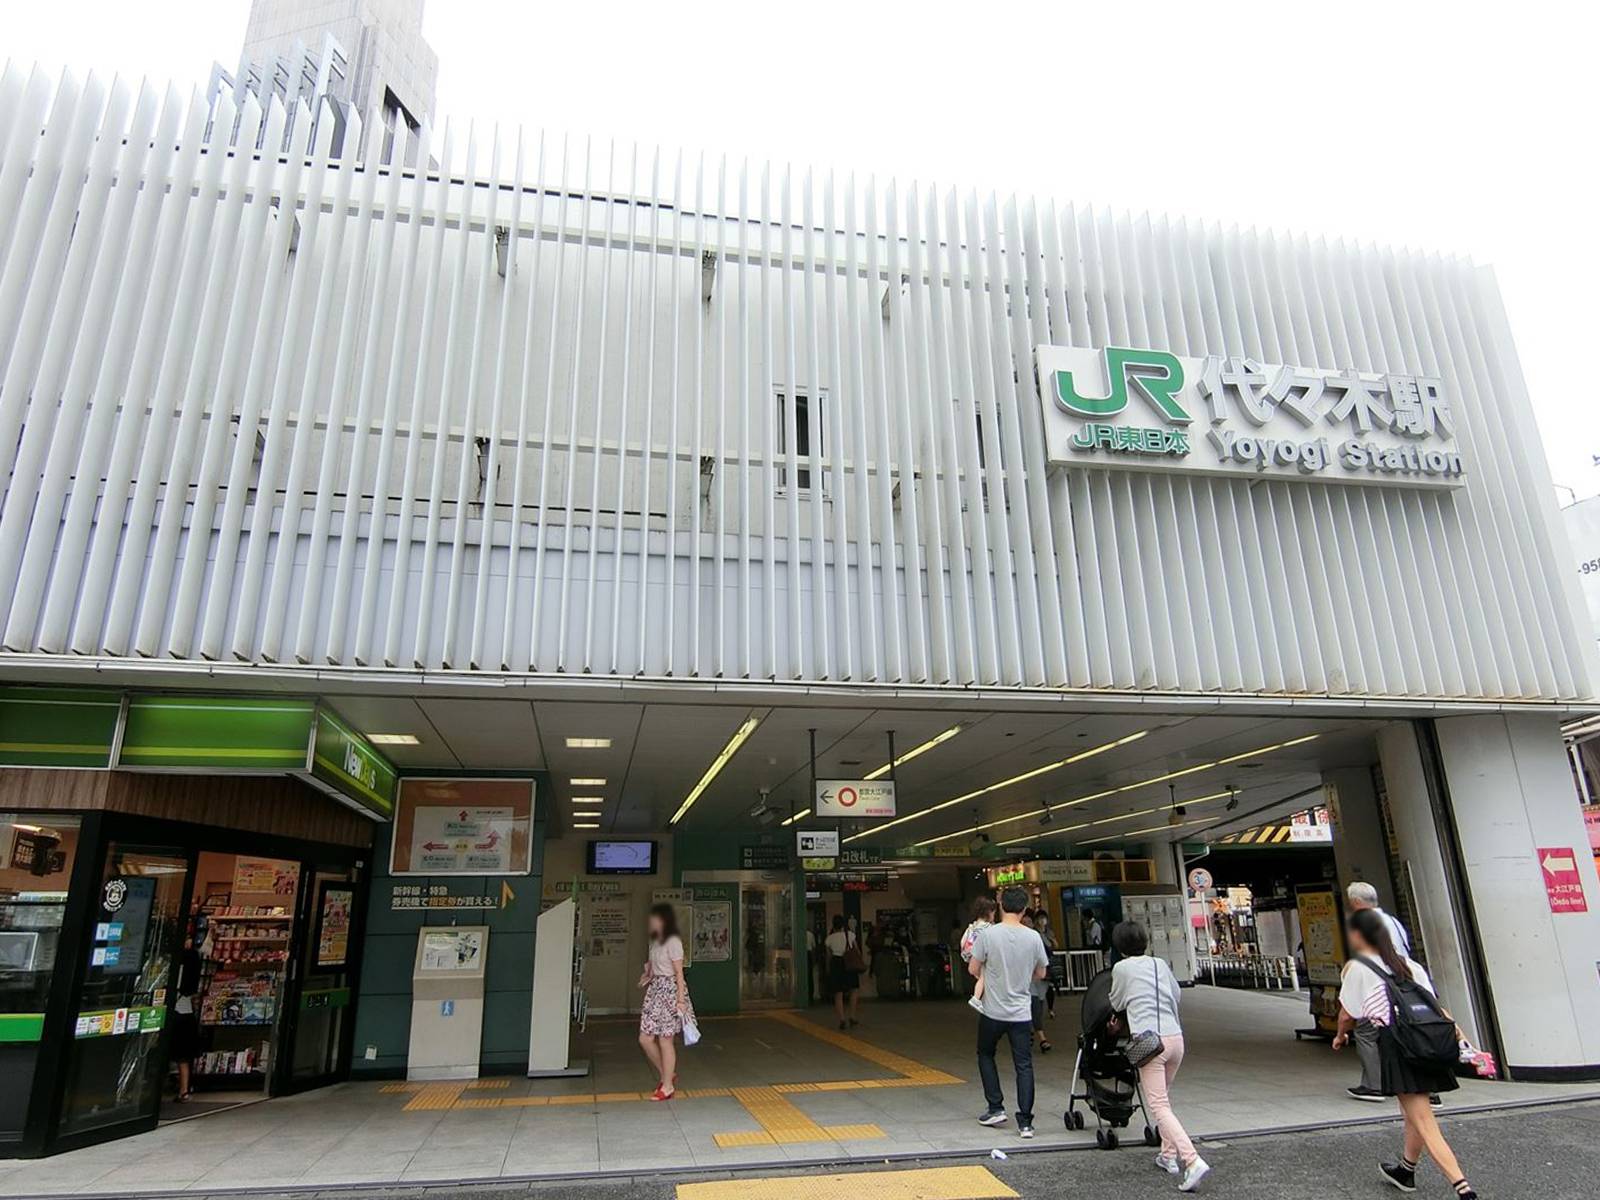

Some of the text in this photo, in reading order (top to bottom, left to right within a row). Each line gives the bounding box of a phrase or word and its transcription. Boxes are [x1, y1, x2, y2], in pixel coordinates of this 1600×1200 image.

[1053, 346, 1194, 424] JR
[1200, 355, 1456, 438] 代々木駅
[1072, 422, 1191, 454] JR東日本
[1208, 429, 1467, 475] Yoyogi Station
[392, 885, 449, 896] 新幹線・特急
